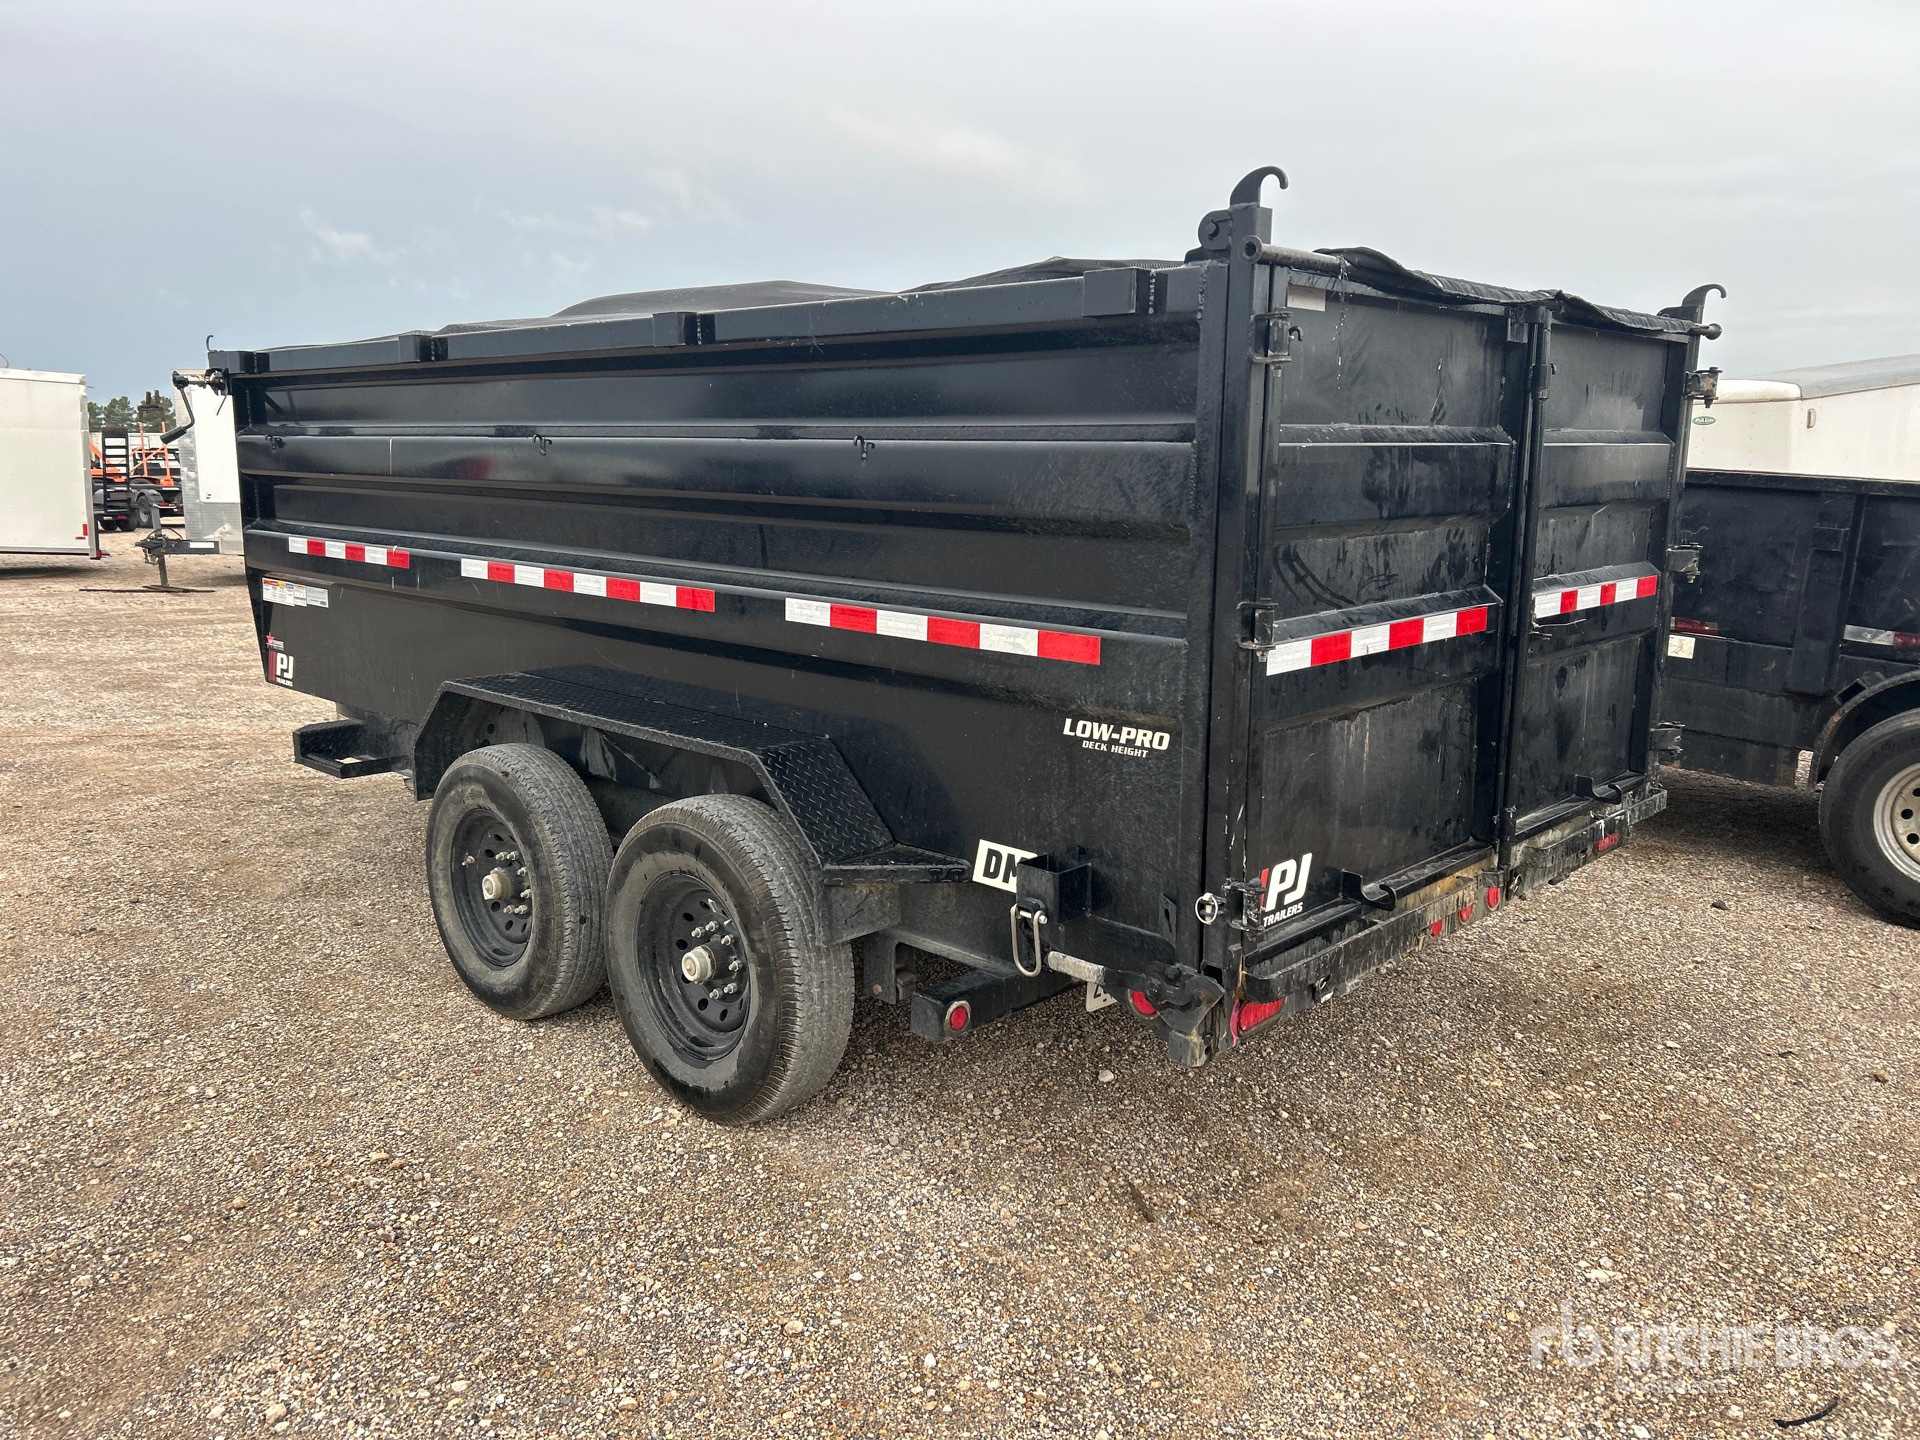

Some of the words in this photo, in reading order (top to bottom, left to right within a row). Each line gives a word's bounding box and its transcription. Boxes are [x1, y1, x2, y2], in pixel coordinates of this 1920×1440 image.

[276, 652, 294, 680] PJ
[1063, 718, 1170, 750] LOW-PRO
[1082, 740, 1107, 751] DECK
[1111, 745, 1149, 758] HEIGHT
[1265, 852, 1313, 912] PJ
[1263, 901, 1304, 927] TRAILERS
